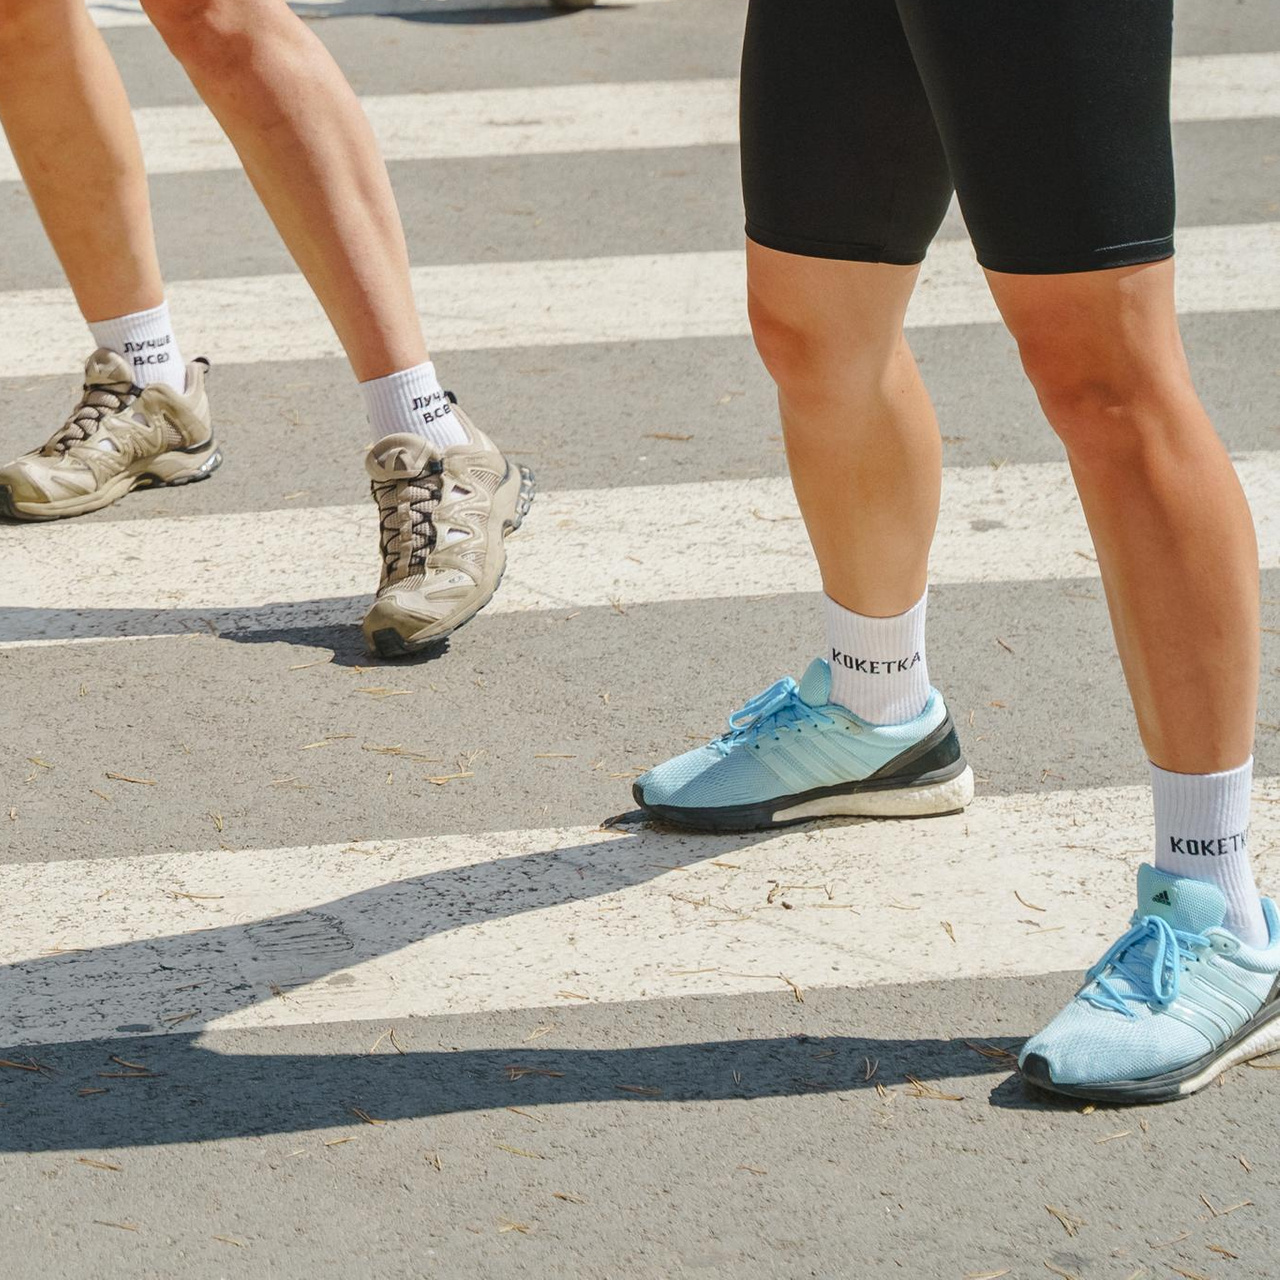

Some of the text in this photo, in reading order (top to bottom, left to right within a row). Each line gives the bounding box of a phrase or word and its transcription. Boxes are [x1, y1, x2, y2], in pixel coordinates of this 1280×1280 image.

[124, 334, 171, 353] ЛУЧШЕ
[412, 391, 446, 411] ЛУЧ
[832, 647, 921, 674] КОКЕТКА
[1170, 825, 1250, 857] КОКЕТК
